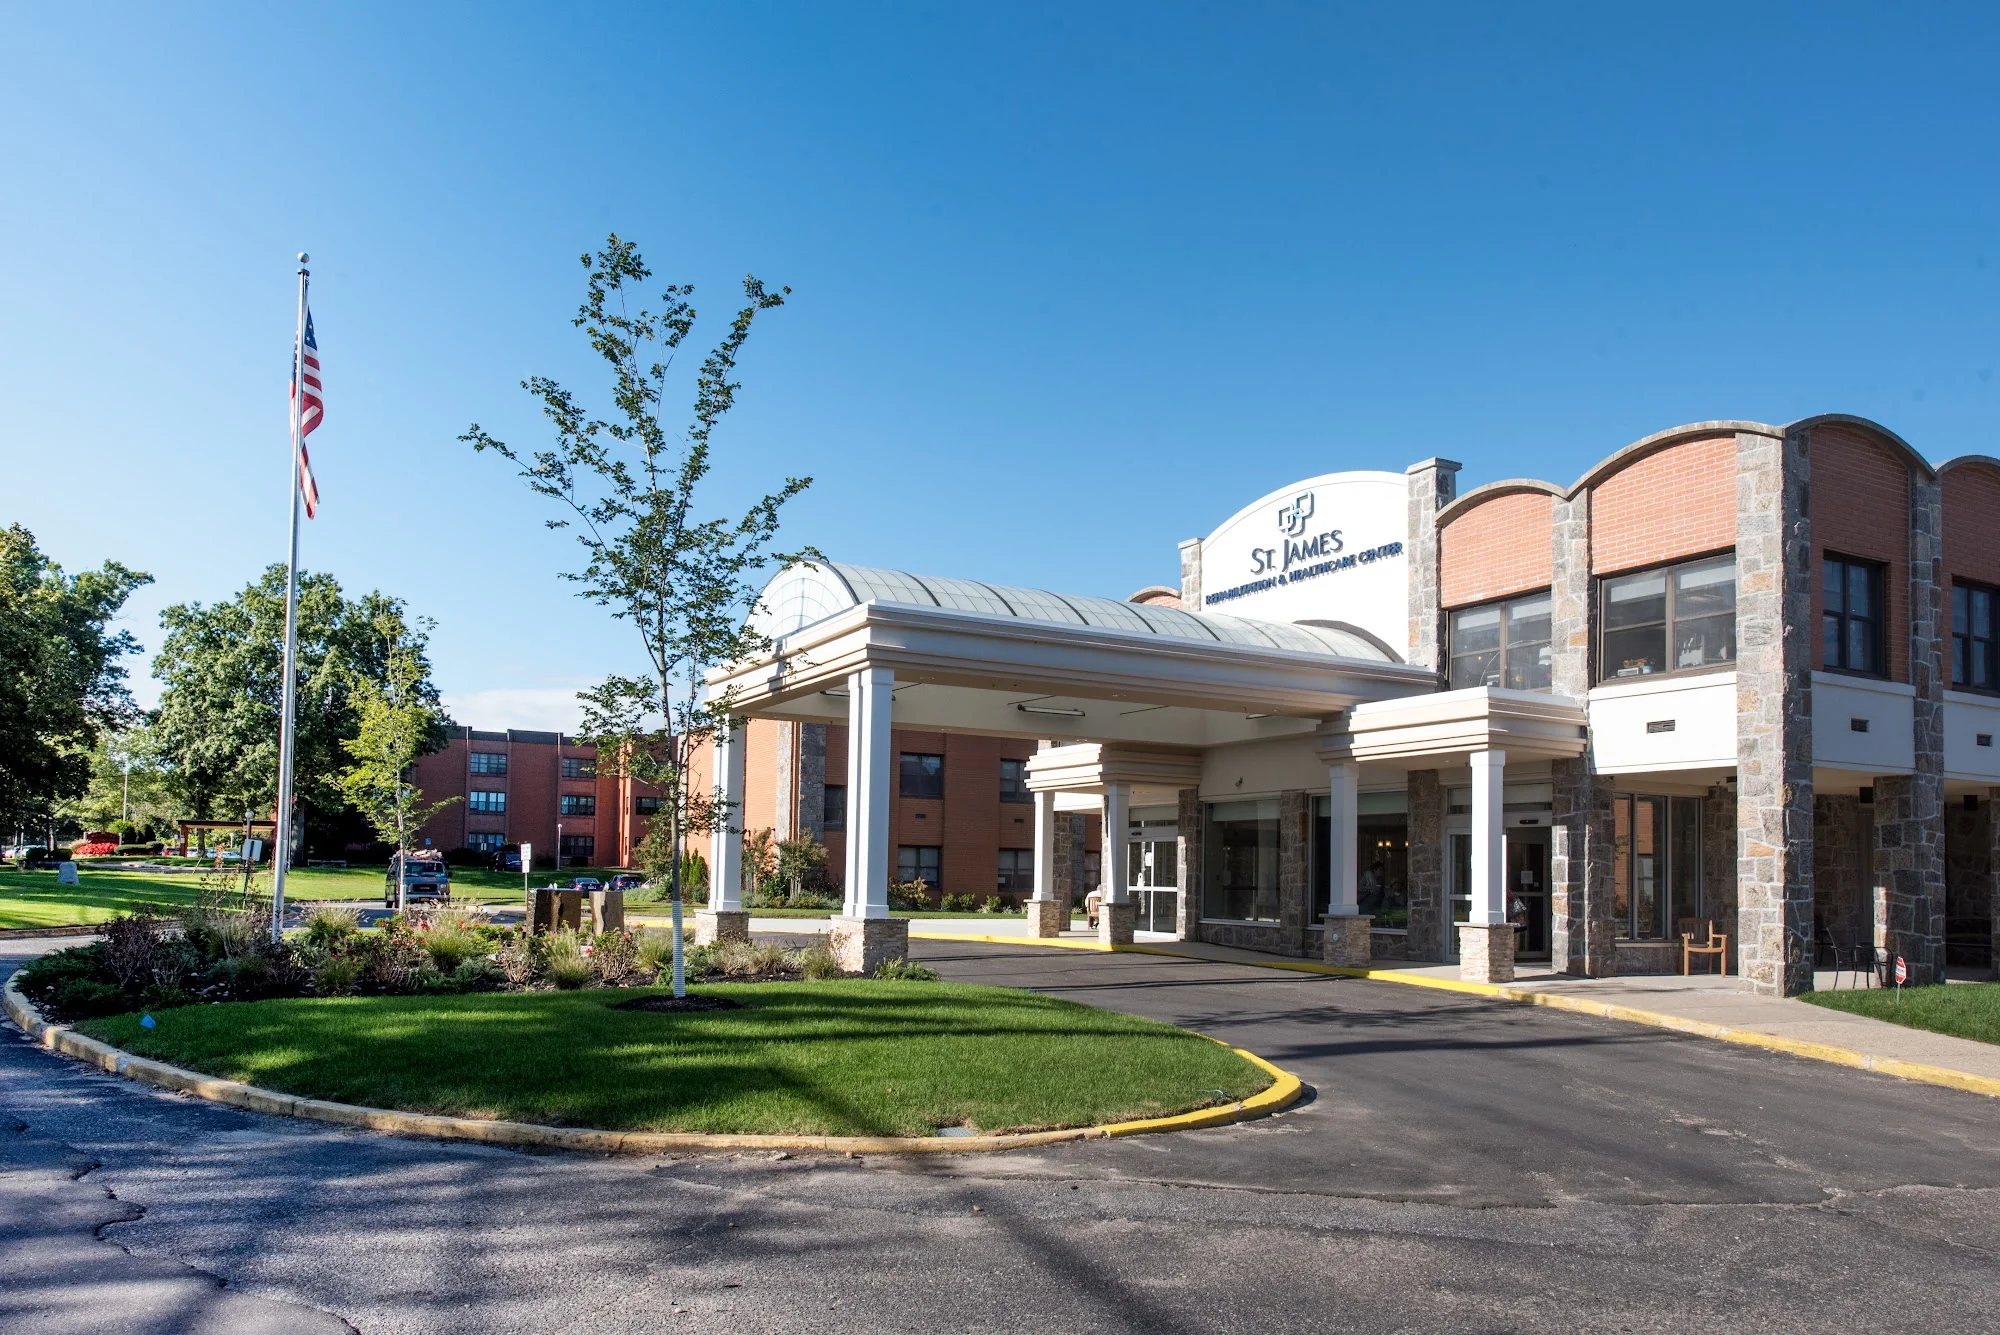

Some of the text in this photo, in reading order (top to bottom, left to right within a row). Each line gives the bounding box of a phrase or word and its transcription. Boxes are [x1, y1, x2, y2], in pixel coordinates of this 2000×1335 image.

[1206, 541, 1404, 607] REHABILITATION & HEALTHCARE CENTER
[1282, 529, 1343, 573] JAMES
